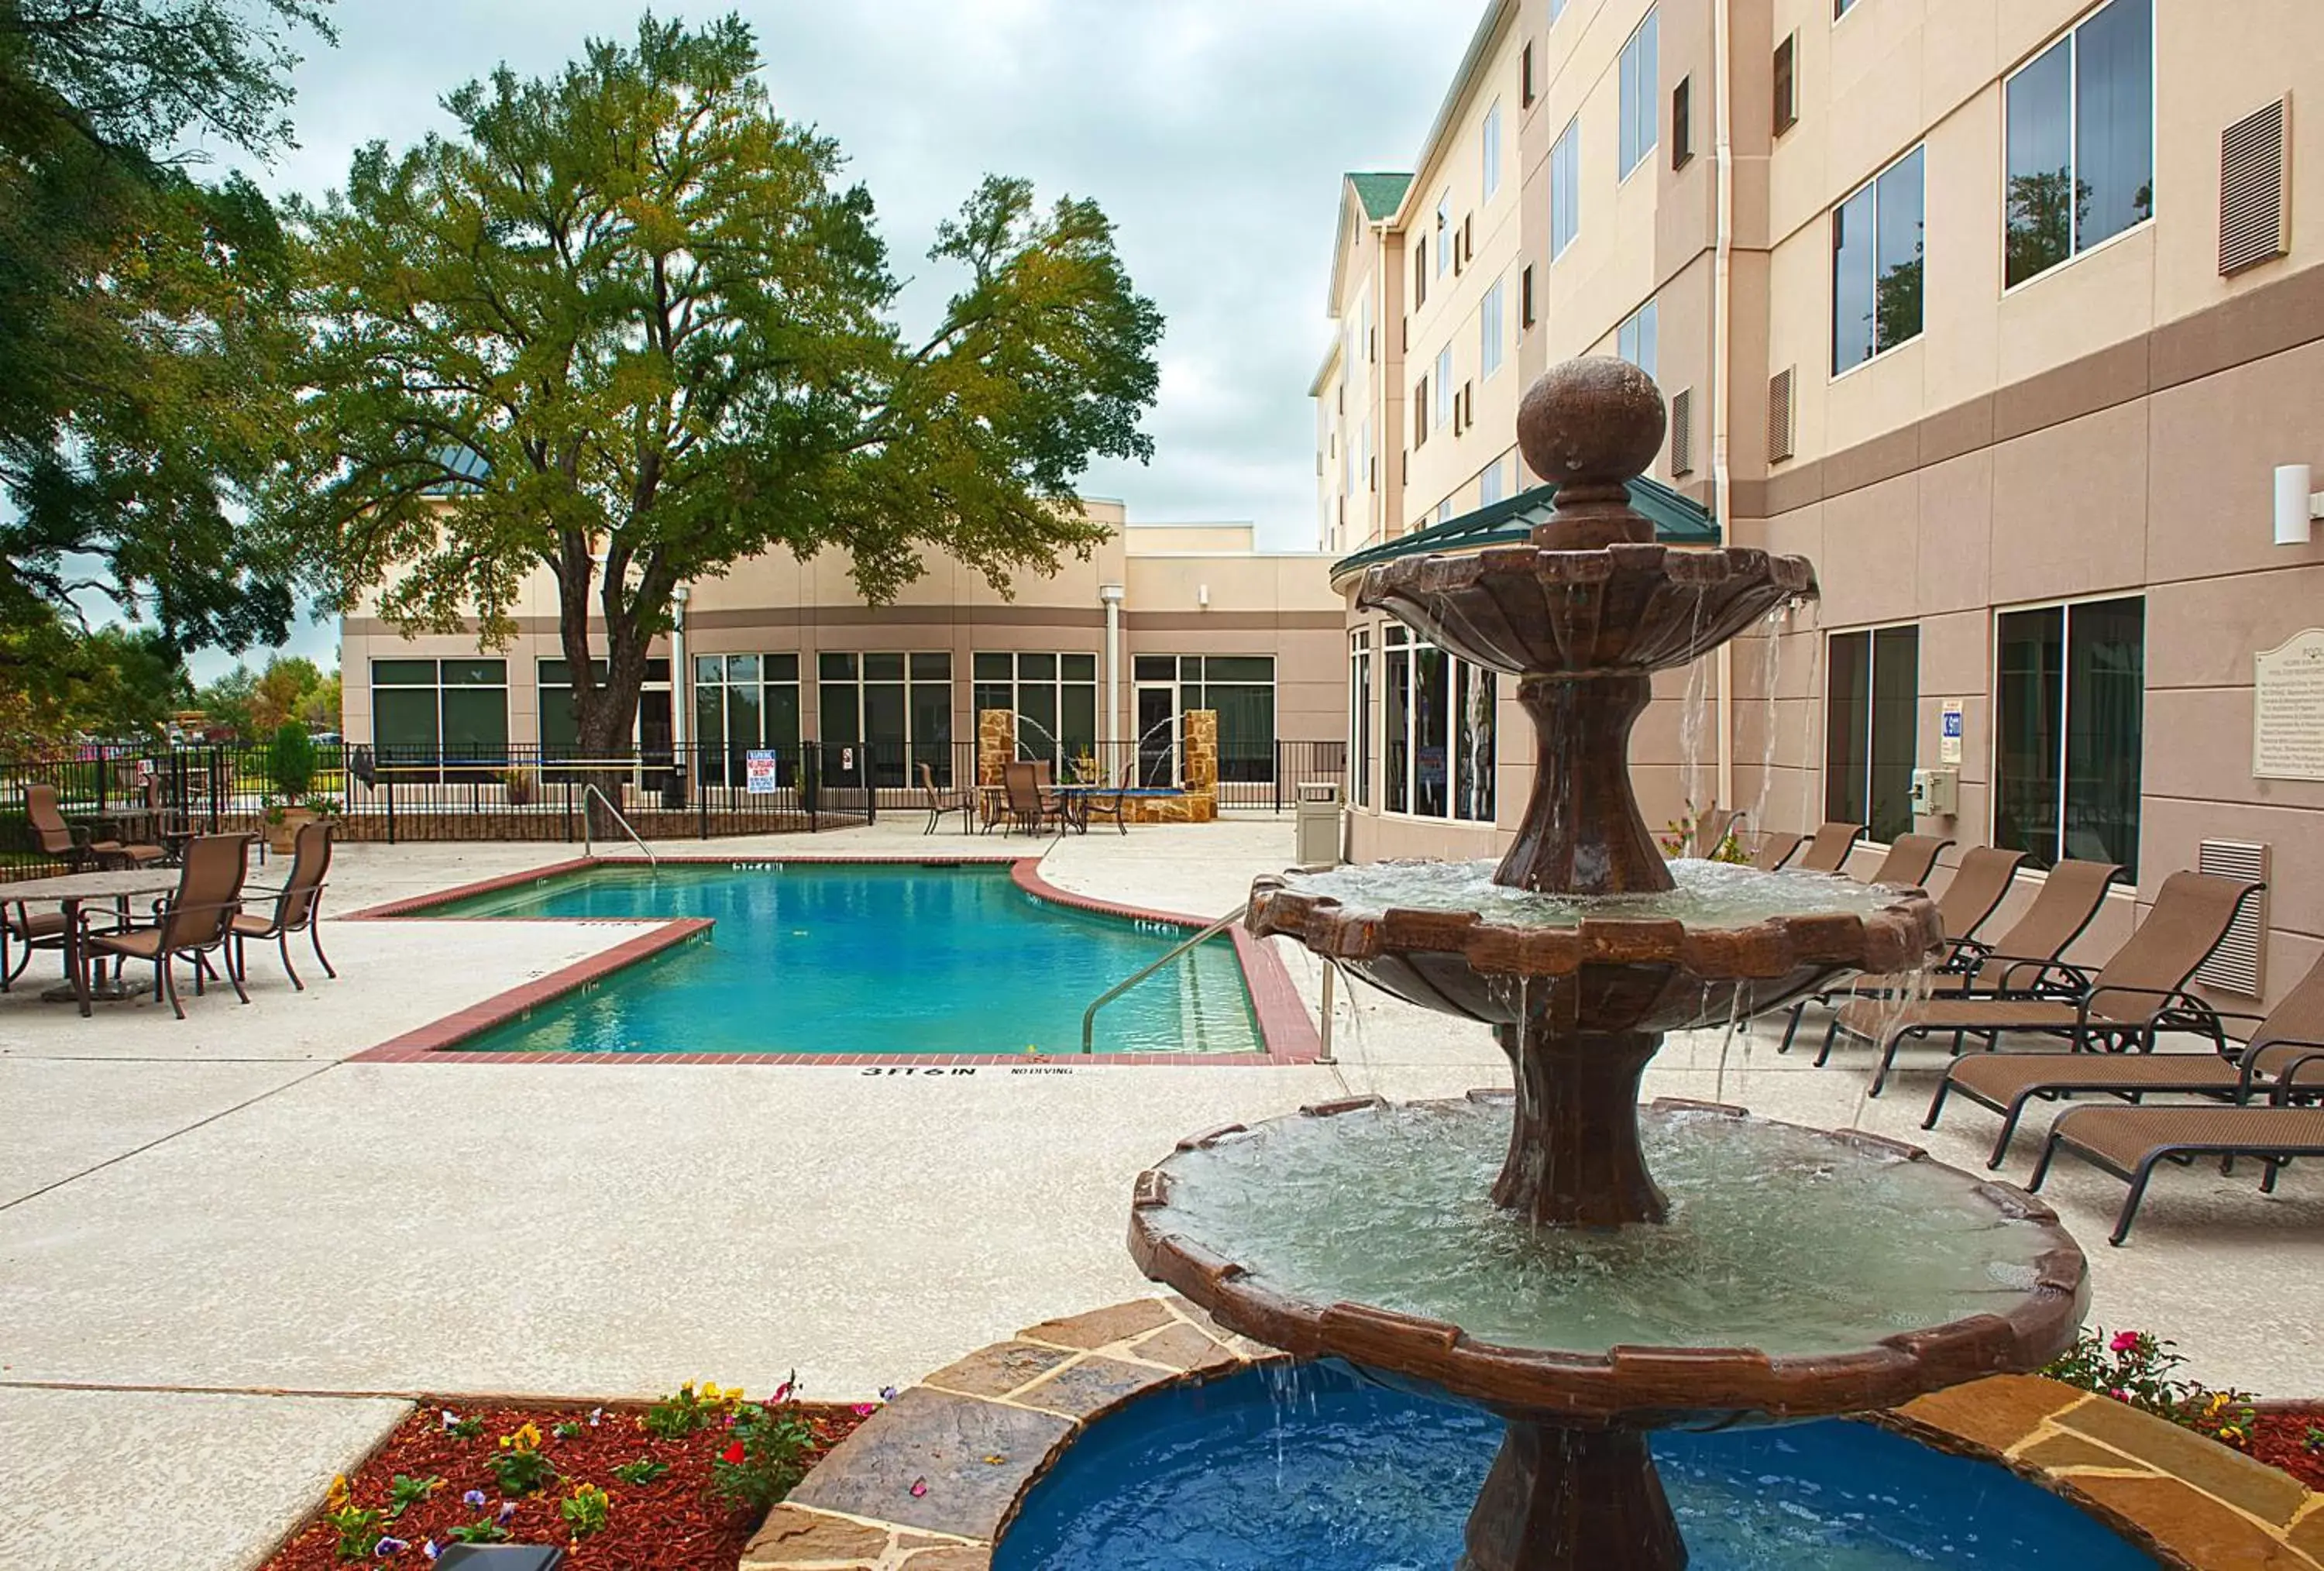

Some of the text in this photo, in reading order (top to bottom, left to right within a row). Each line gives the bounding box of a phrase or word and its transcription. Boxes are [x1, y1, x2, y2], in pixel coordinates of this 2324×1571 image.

[861, 1067, 882, 1075] 3
[888, 1067, 919, 1075] FT
[923, 1067, 944, 1075] 6
